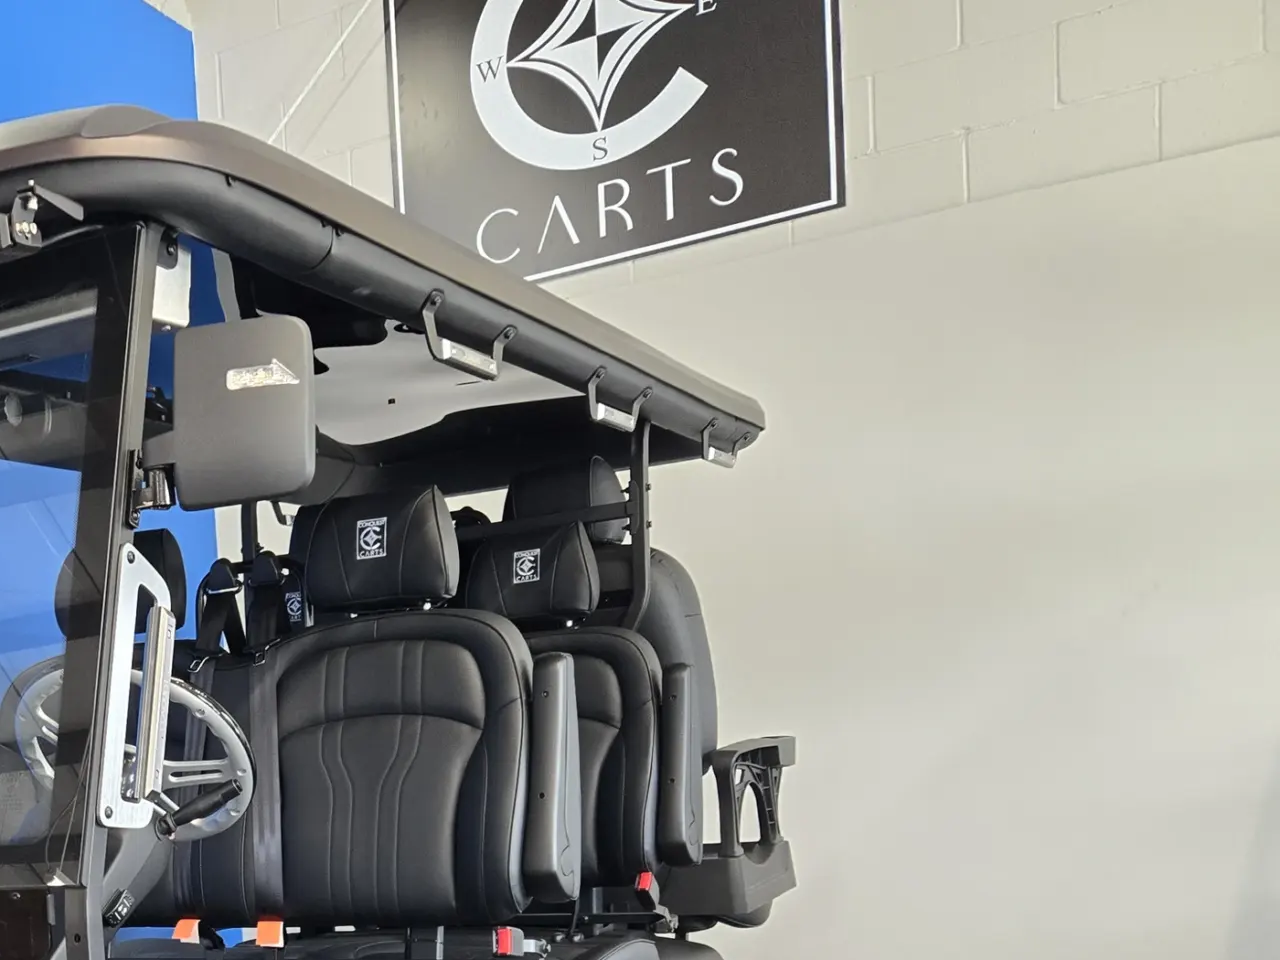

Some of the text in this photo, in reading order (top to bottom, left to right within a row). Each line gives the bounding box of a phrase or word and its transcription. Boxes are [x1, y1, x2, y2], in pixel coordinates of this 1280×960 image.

[476, 56, 505, 84] W
[592, 136, 609, 161] S
[476, 147, 745, 265] CARTS
